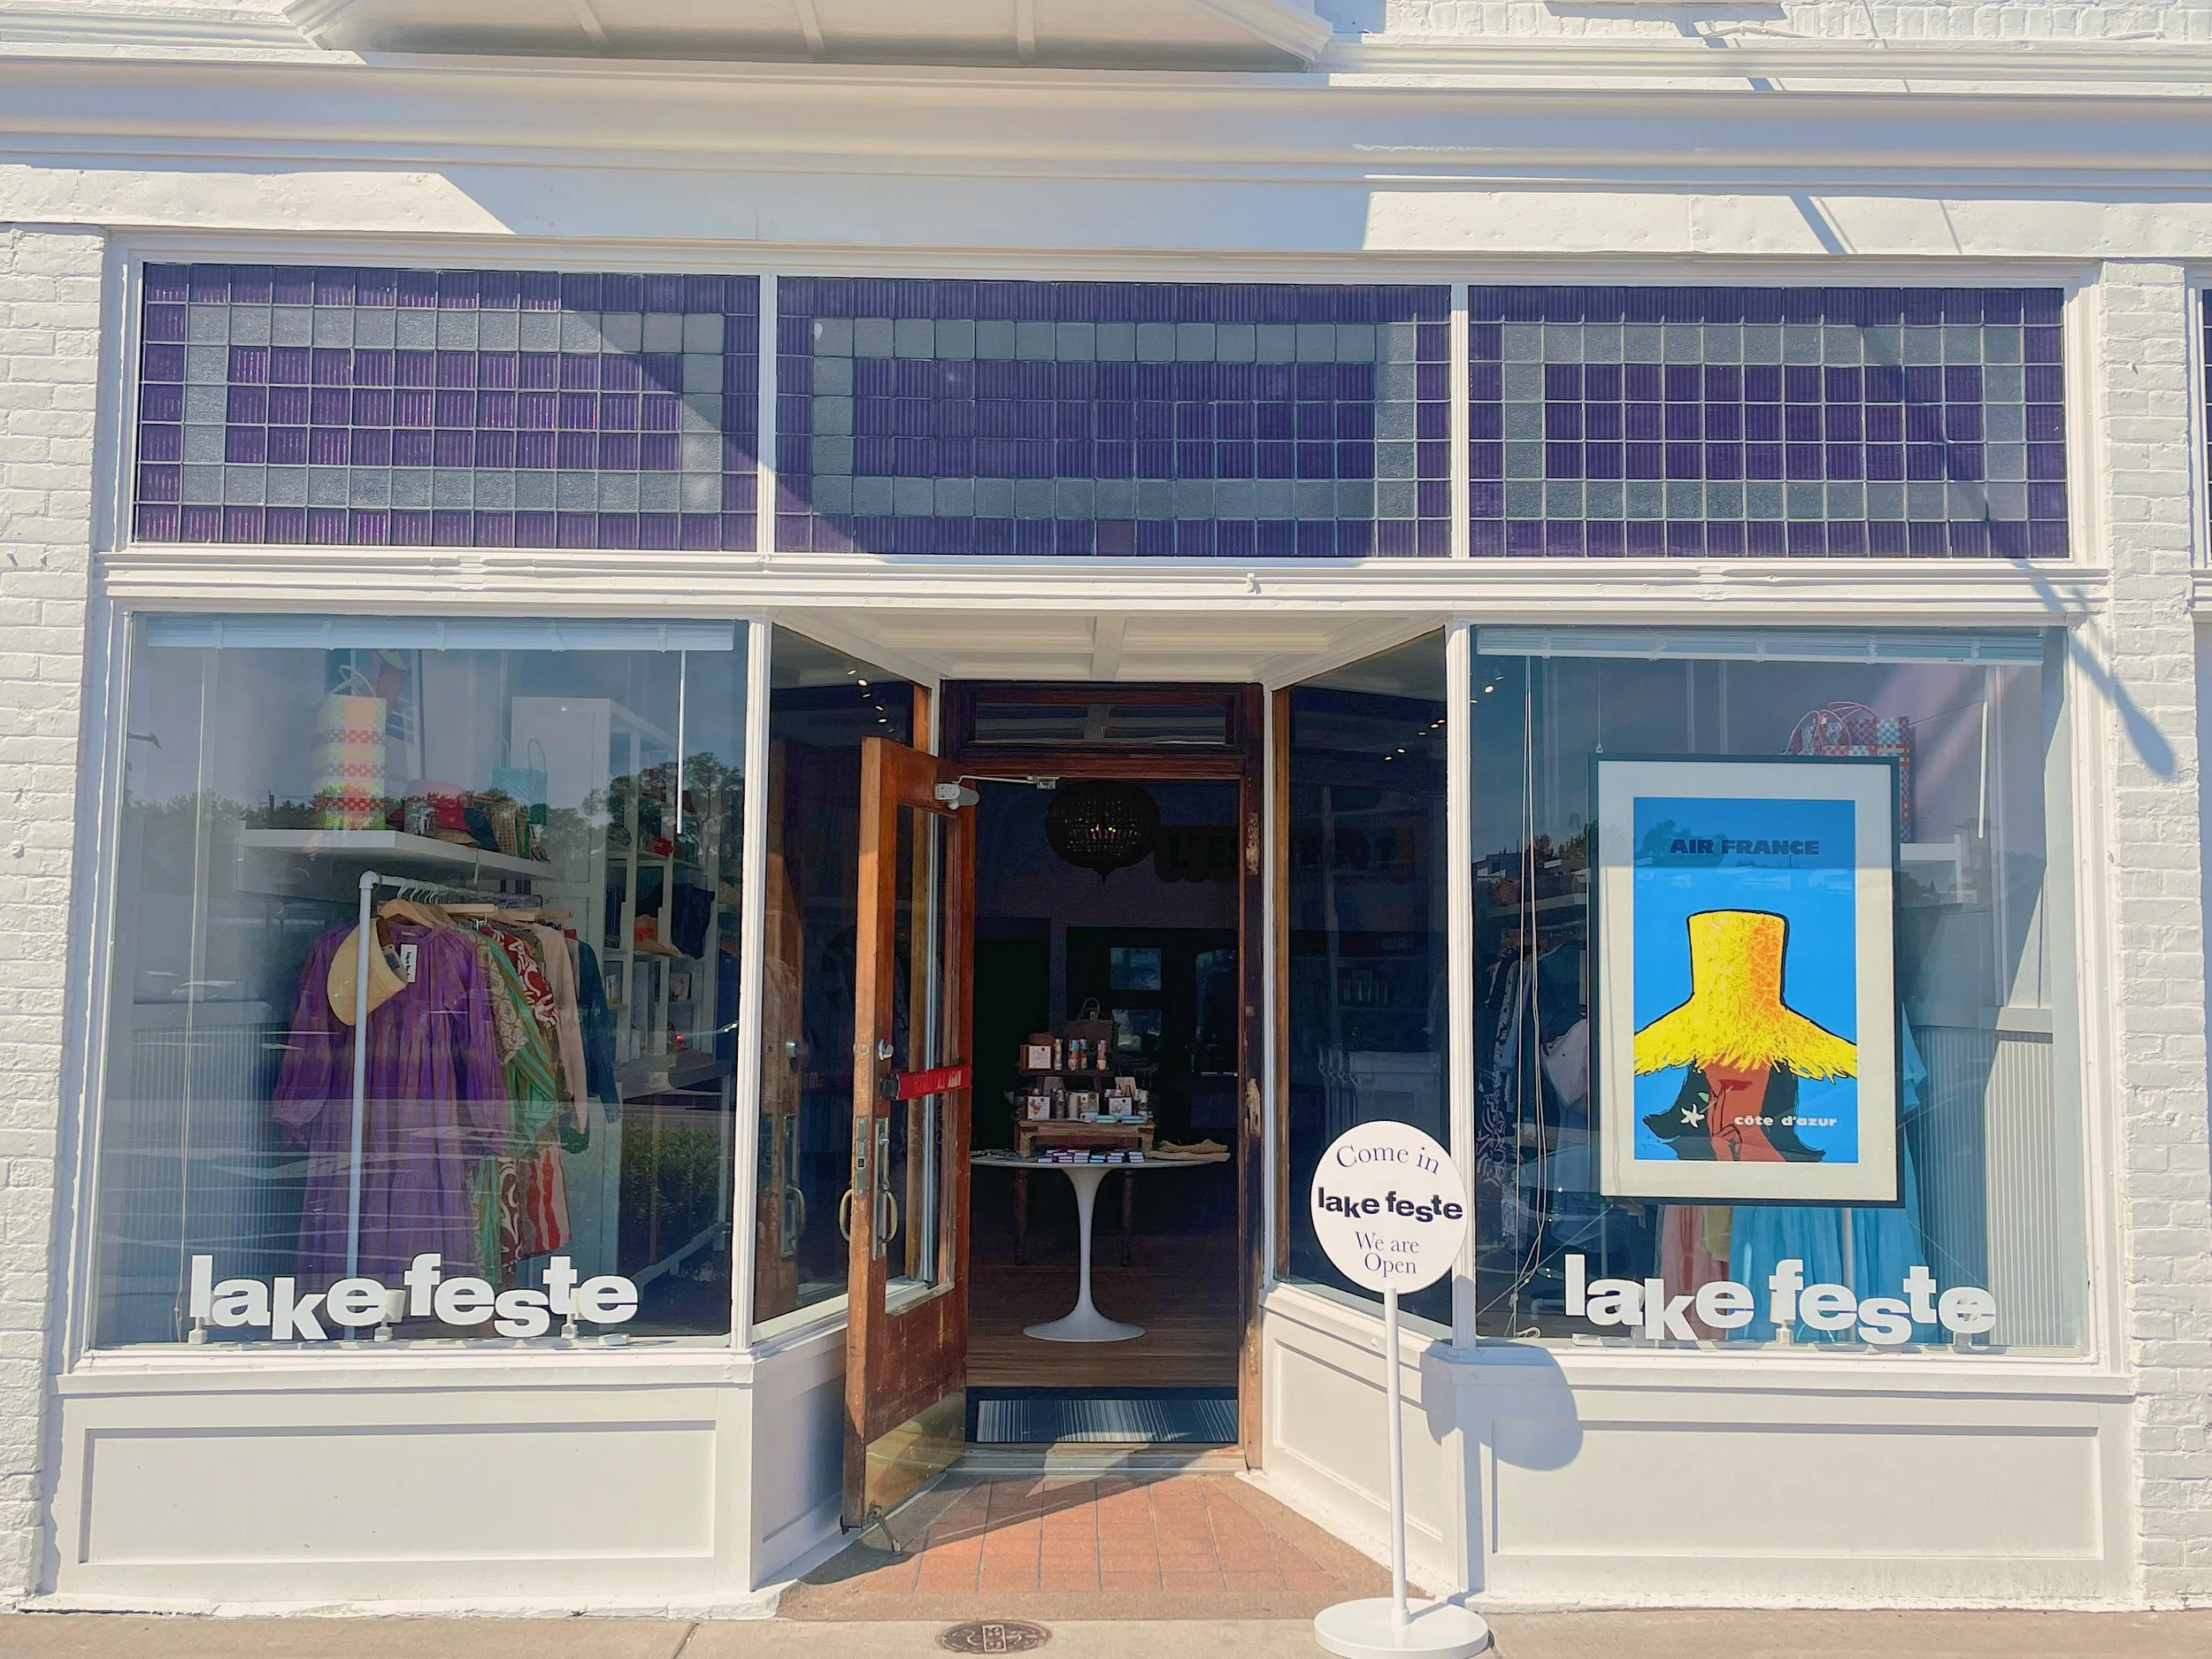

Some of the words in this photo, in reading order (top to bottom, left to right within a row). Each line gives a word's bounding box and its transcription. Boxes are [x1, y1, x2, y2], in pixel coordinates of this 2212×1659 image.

[1670, 839, 1715, 854] AIR
[1721, 840, 1819, 856] FRANCE
[1734, 1115, 1774, 1126] côte
[1780, 1115, 1838, 1127] d'azur
[1336, 1144, 1409, 1168] Come
[1416, 1147, 1440, 1175] in
[1317, 1186, 1380, 1219] lake
[1385, 1190, 1463, 1223] feste
[1355, 1231, 1385, 1252] We
[1390, 1239, 1420, 1254] are
[1363, 1252, 1417, 1279] Open
[189, 1254, 387, 1341] lake
[403, 1253, 639, 1339] feste
[1564, 1253, 1755, 1340] lake
[1769, 1258, 1997, 1345] feste
